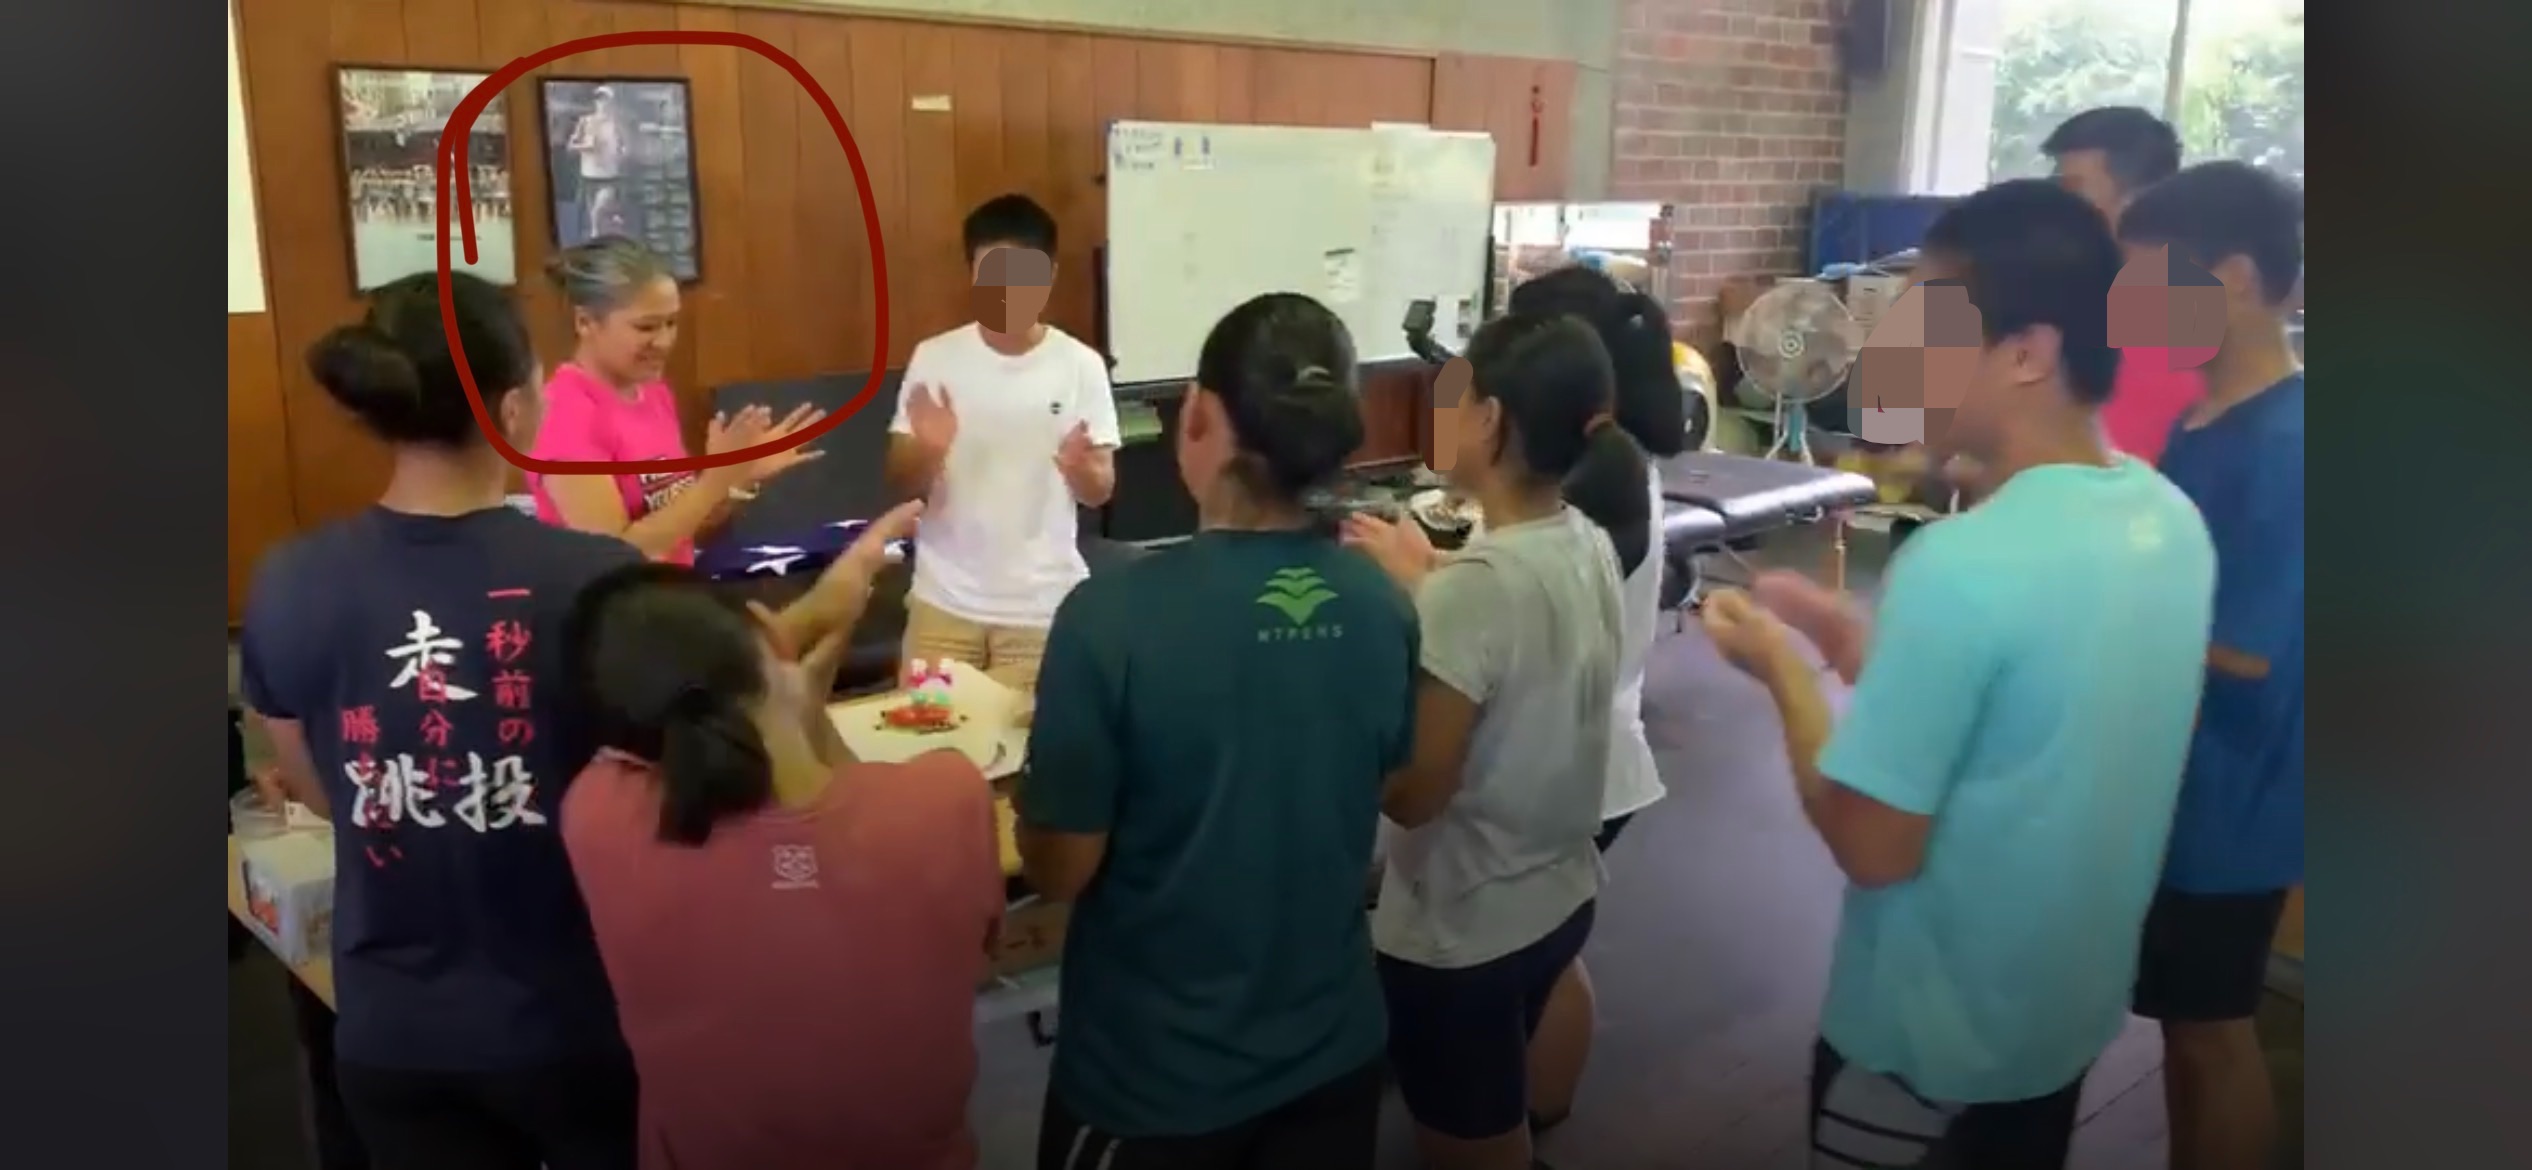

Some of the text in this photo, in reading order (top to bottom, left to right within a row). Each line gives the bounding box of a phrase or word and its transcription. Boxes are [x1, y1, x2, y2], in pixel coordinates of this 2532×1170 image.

[385, 609, 480, 701] 走
[486, 588, 533, 745] 一秒前の
